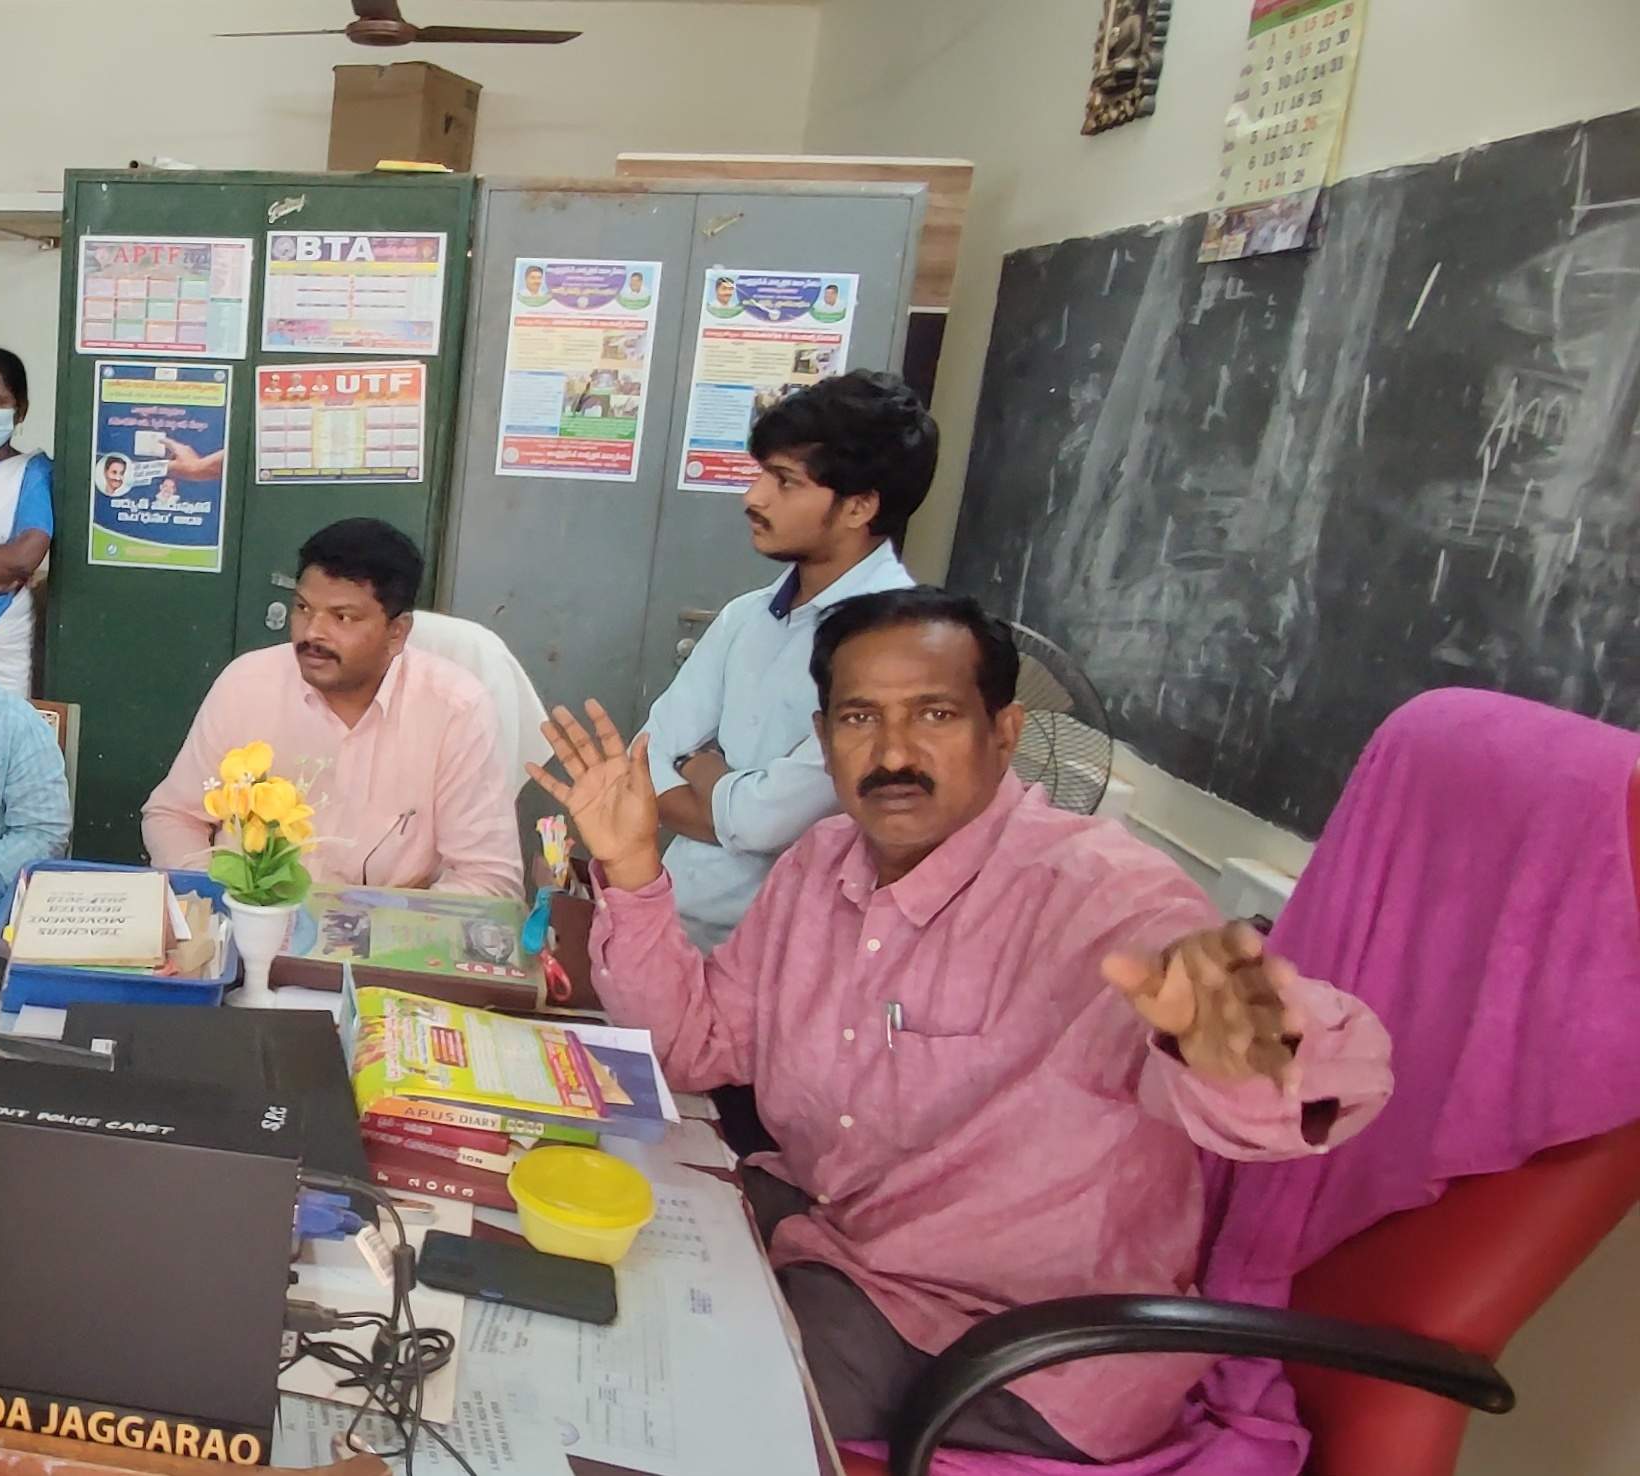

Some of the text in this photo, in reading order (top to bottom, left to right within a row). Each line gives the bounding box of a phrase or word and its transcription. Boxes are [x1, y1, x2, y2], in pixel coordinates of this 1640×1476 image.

[113, 245, 183, 265] APTF
[296, 236, 376, 262] BTA
[336, 373, 413, 393] UTF
[30, 915, 127, 925] MOVEMENT
[38, 927, 123, 937] TEACHERS
[36, 1112, 101, 1128] POLICE
[105, 1121, 175, 1136] CADET
[404, 1106, 455, 1122] APUS
[459, 1113, 499, 1128] DIARY
[40, 1402, 260, 1466] JAGGARAO
